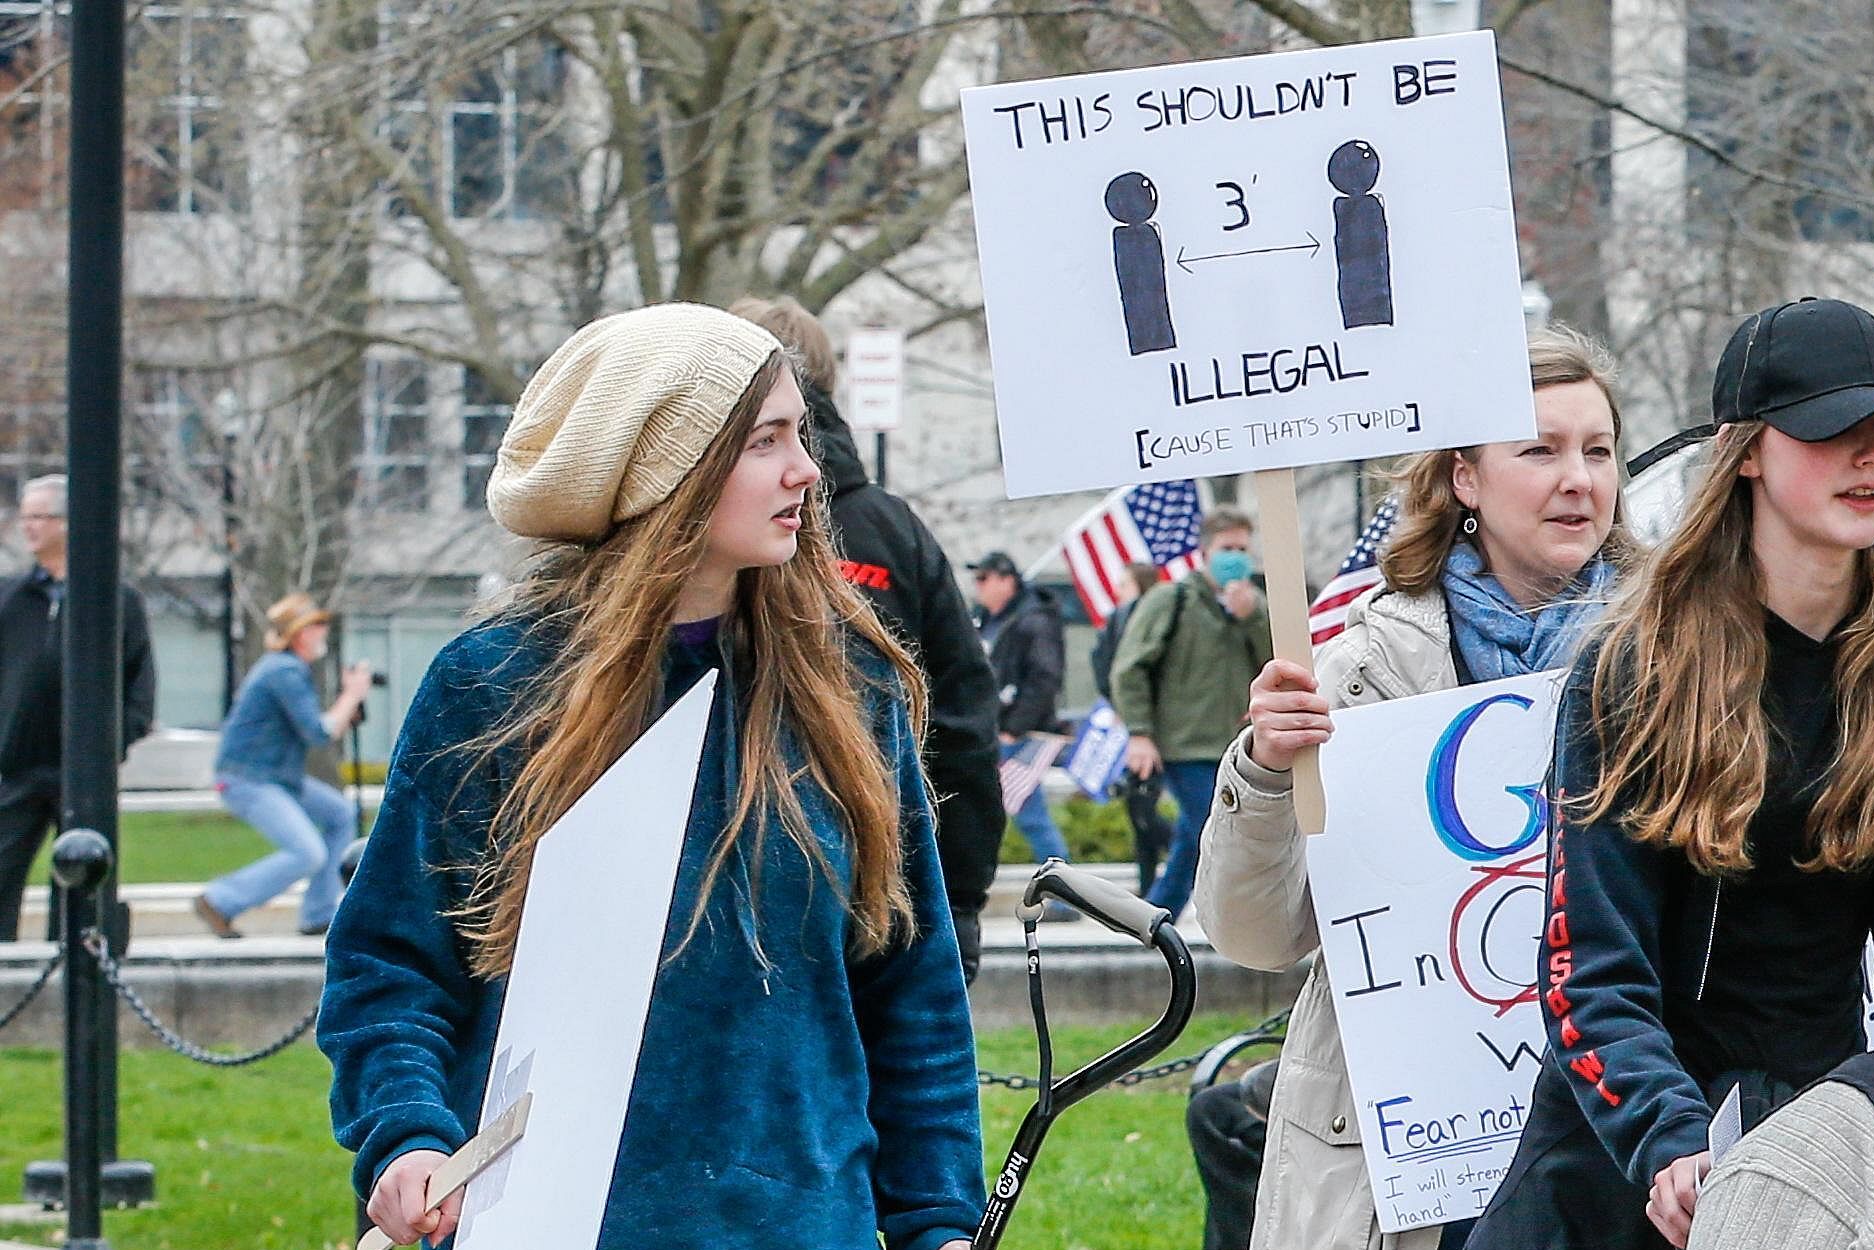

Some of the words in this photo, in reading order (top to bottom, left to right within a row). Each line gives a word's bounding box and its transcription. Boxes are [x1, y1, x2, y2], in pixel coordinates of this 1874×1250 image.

[993, 94, 1112, 149] THIS
[1137, 72, 1357, 132] SHOULDN'T
[1393, 60, 1457, 105] BE
[1216, 174, 1257, 231] 3'
[1170, 341, 1369, 406] ILLEGAL
[1244, 415, 1320, 447] THAT'S
[1331, 906, 1446, 997] In
[1479, 1095, 1525, 1133] not
[996, 1151, 1029, 1200] hugo
[1384, 1175, 1404, 1199] I
[1418, 1168, 1447, 1193] will
